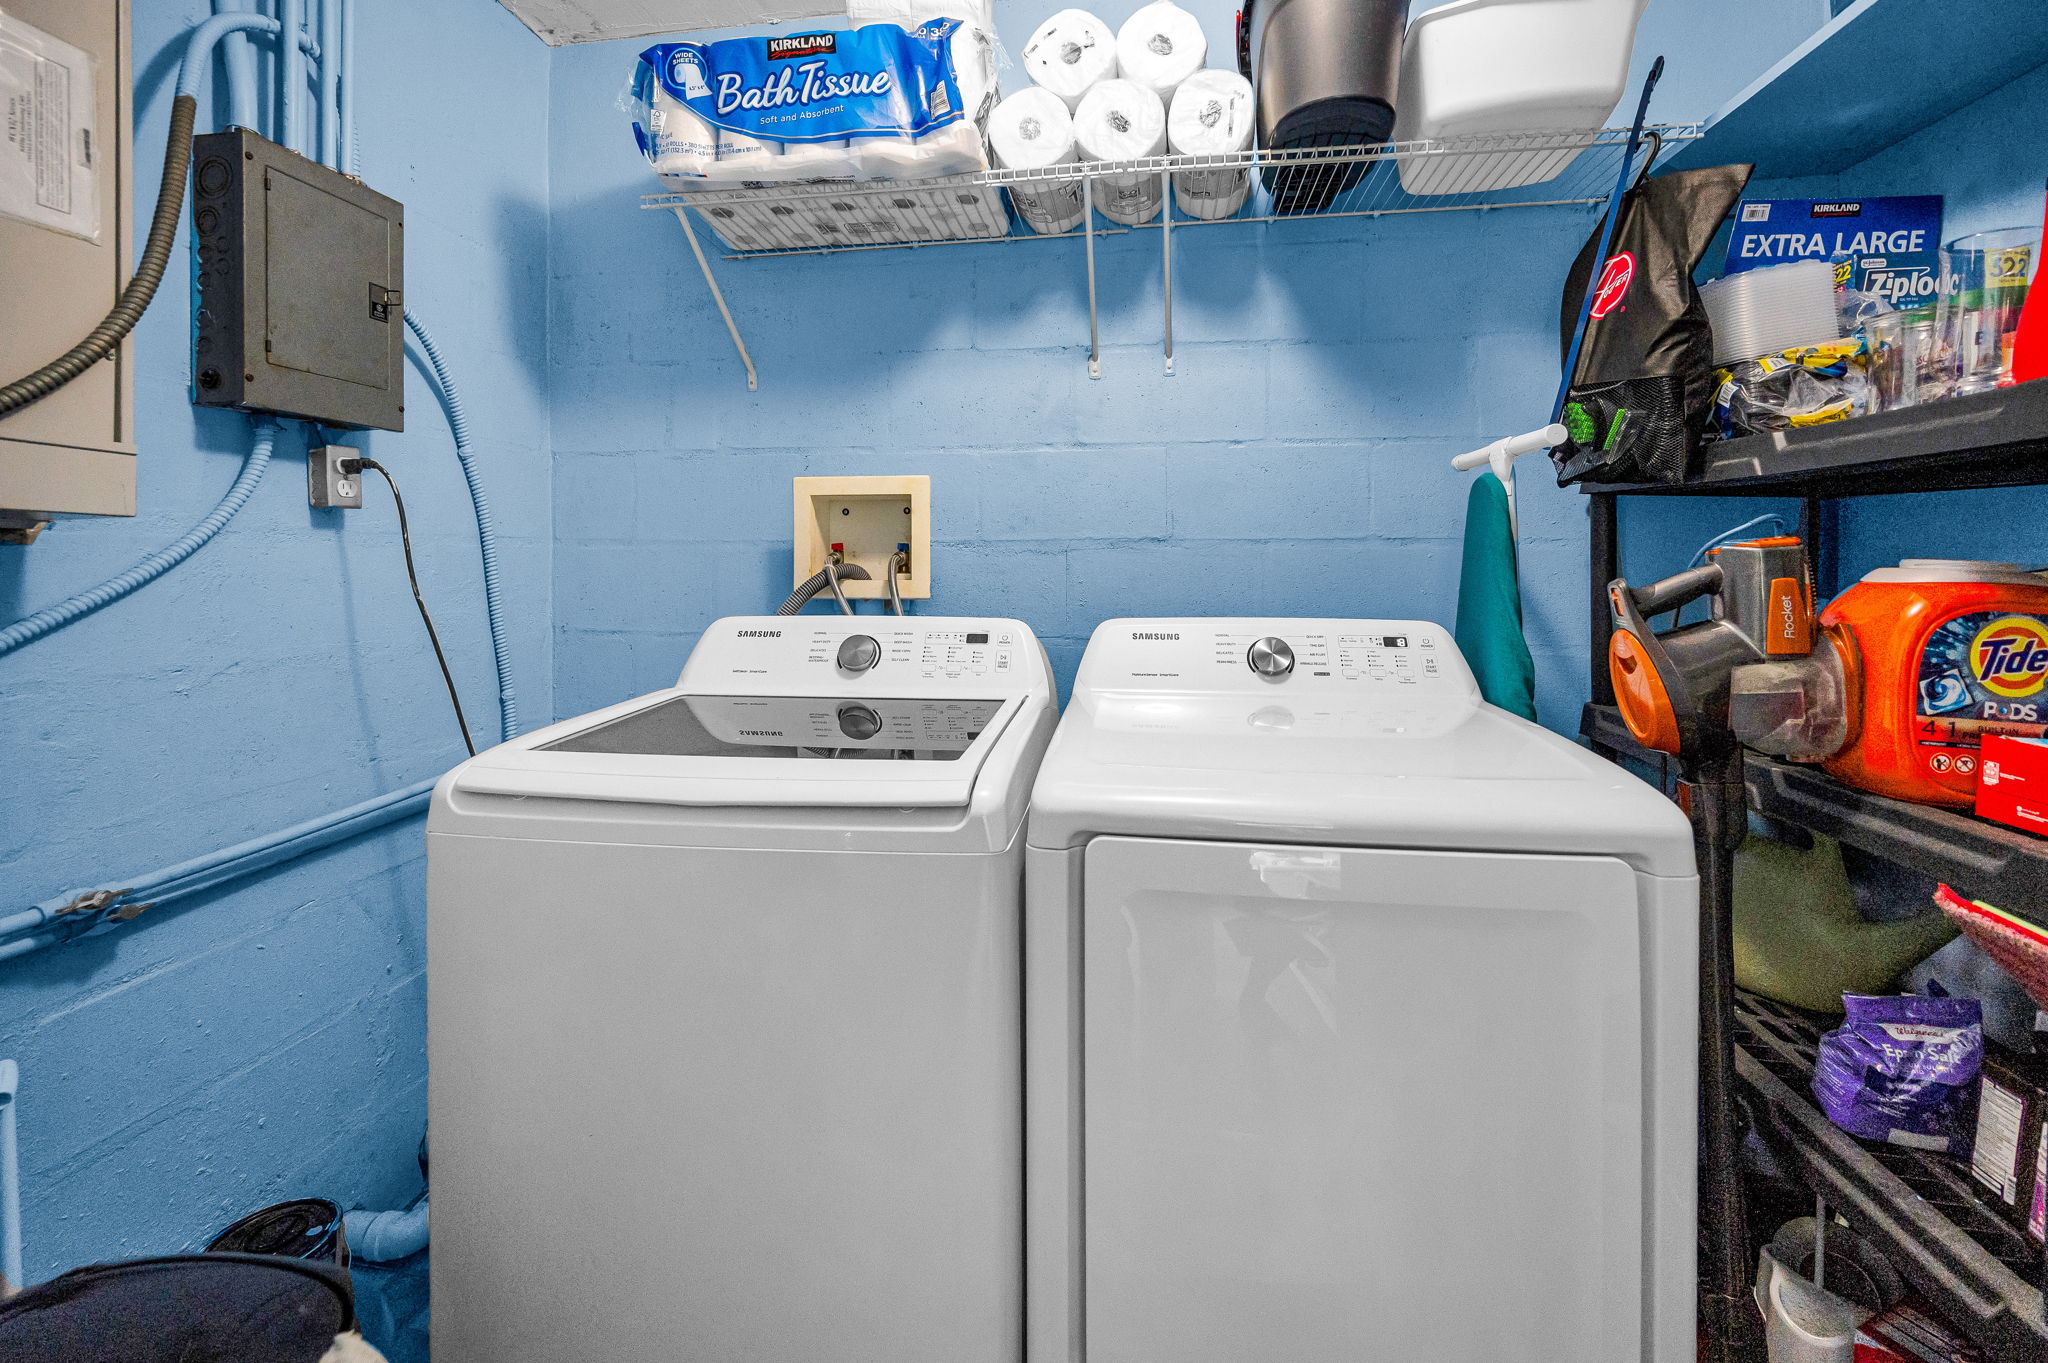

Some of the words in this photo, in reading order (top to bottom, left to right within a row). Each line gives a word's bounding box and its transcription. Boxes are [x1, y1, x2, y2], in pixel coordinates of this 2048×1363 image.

[770, 34, 834, 52] KIRKLAND
[717, 69, 801, 114] Bath
[798, 61, 892, 105] Tissue
[760, 116, 779, 125] Soft
[780, 113, 797, 122] and
[799, 104, 844, 120] Absorbent
[1813, 204, 1860, 213] KIRKLAND
[1740, 233, 1826, 257] EXTRA
[1834, 230, 1926, 255] LARGE
[1781, 595, 1795, 639] Rocket
[737, 630, 782, 638] SAMSUNG
[1132, 632, 1180, 641] SAMSUNG
[1977, 637, 2048, 682] Tide
[1983, 702, 2039, 720] PODS
[1895, 1027, 1945, 1038] Walgreens
[1927, 1046, 1962, 1064] Salt
